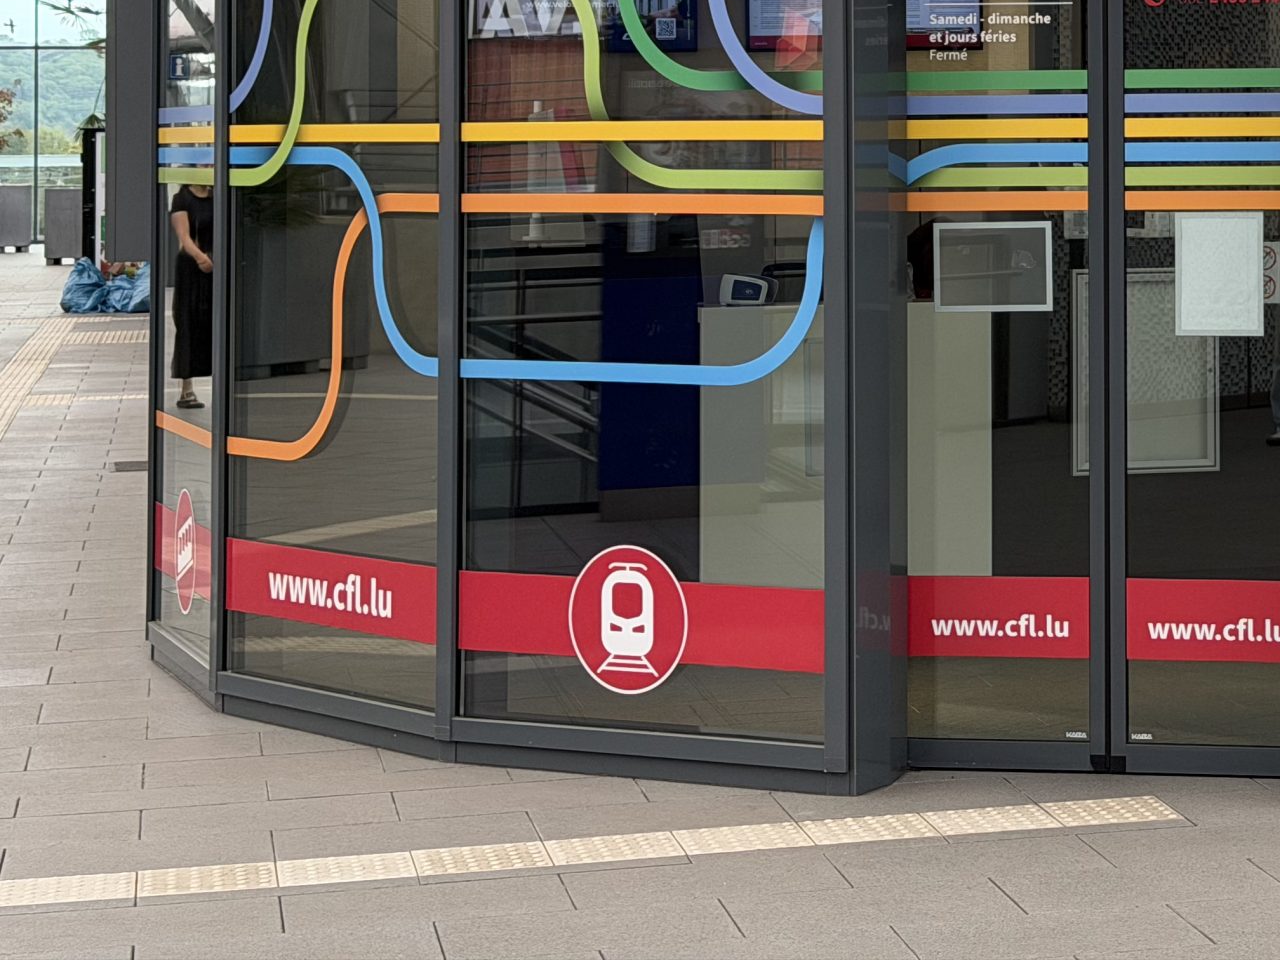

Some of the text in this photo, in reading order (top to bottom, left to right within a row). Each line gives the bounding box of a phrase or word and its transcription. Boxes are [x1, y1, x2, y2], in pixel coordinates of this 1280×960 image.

[929, 12, 1052, 25] Samedi dimanche
[928, 30, 1017, 46] et jours féries
[929, 48, 968, 61] Fermé
[268, 572, 392, 619] www.cfl.lu
[931, 614, 1070, 638] www.cfl.lu
[1065, 731, 1088, 739] KABA
